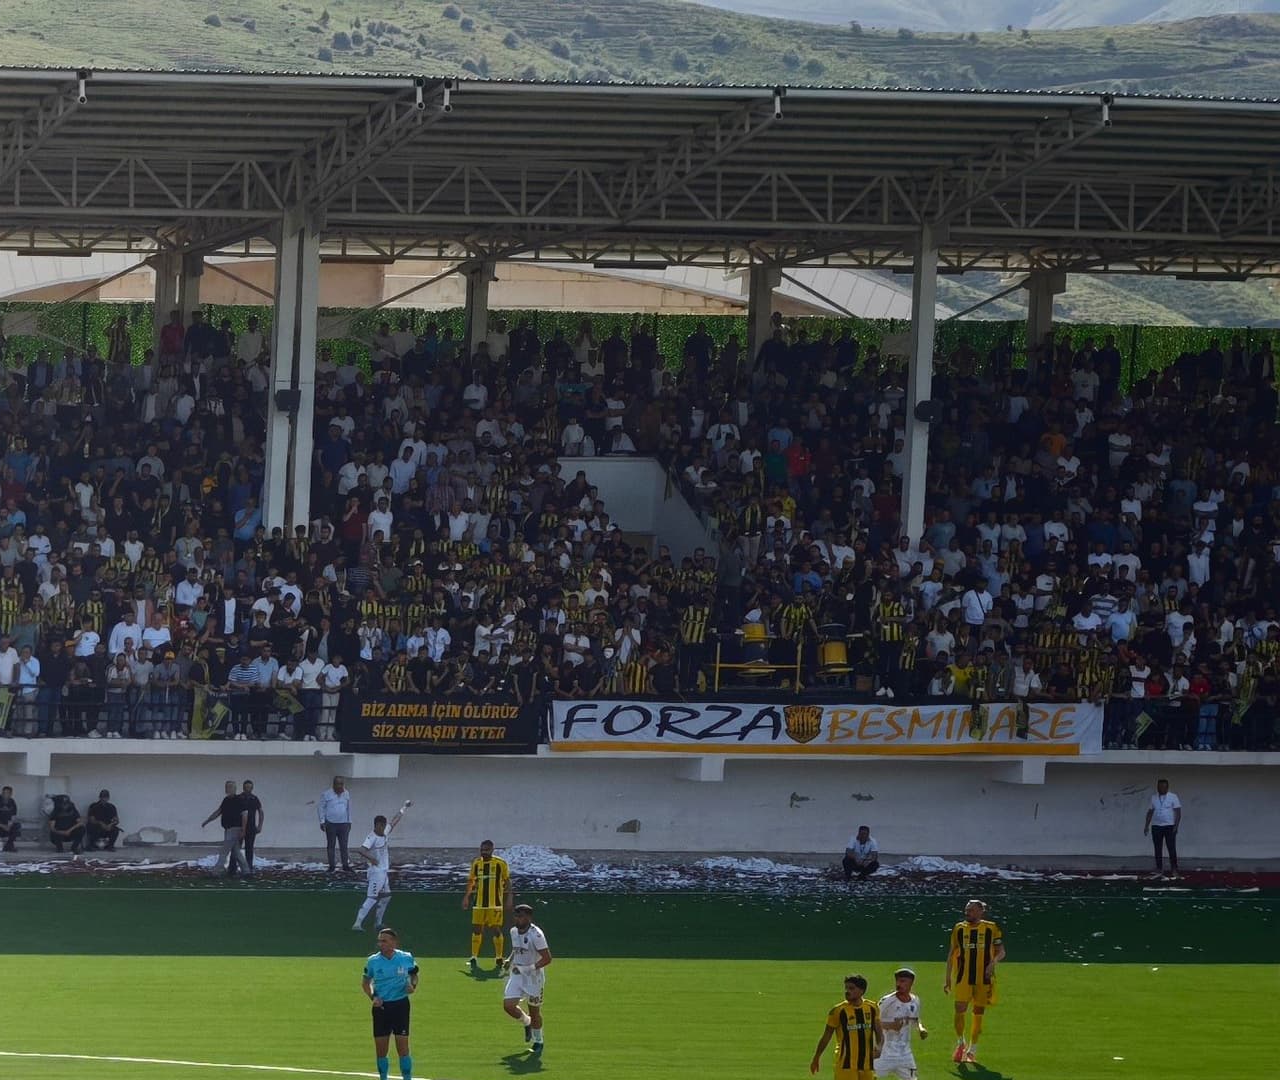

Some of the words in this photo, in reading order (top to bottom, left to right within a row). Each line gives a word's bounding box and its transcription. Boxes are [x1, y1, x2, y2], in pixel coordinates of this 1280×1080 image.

[360, 700, 386, 718] BİZ
[386, 703, 429, 718] ARMA
[431, 701, 462, 721] İÇİN
[463, 701, 520, 719] ÖLÜRÜZ
[371, 721, 395, 738] SİZ
[396, 724, 459, 742] SAVAŞIN
[460, 726, 507, 740] YETER
[560, 703, 782, 741] FORZA
